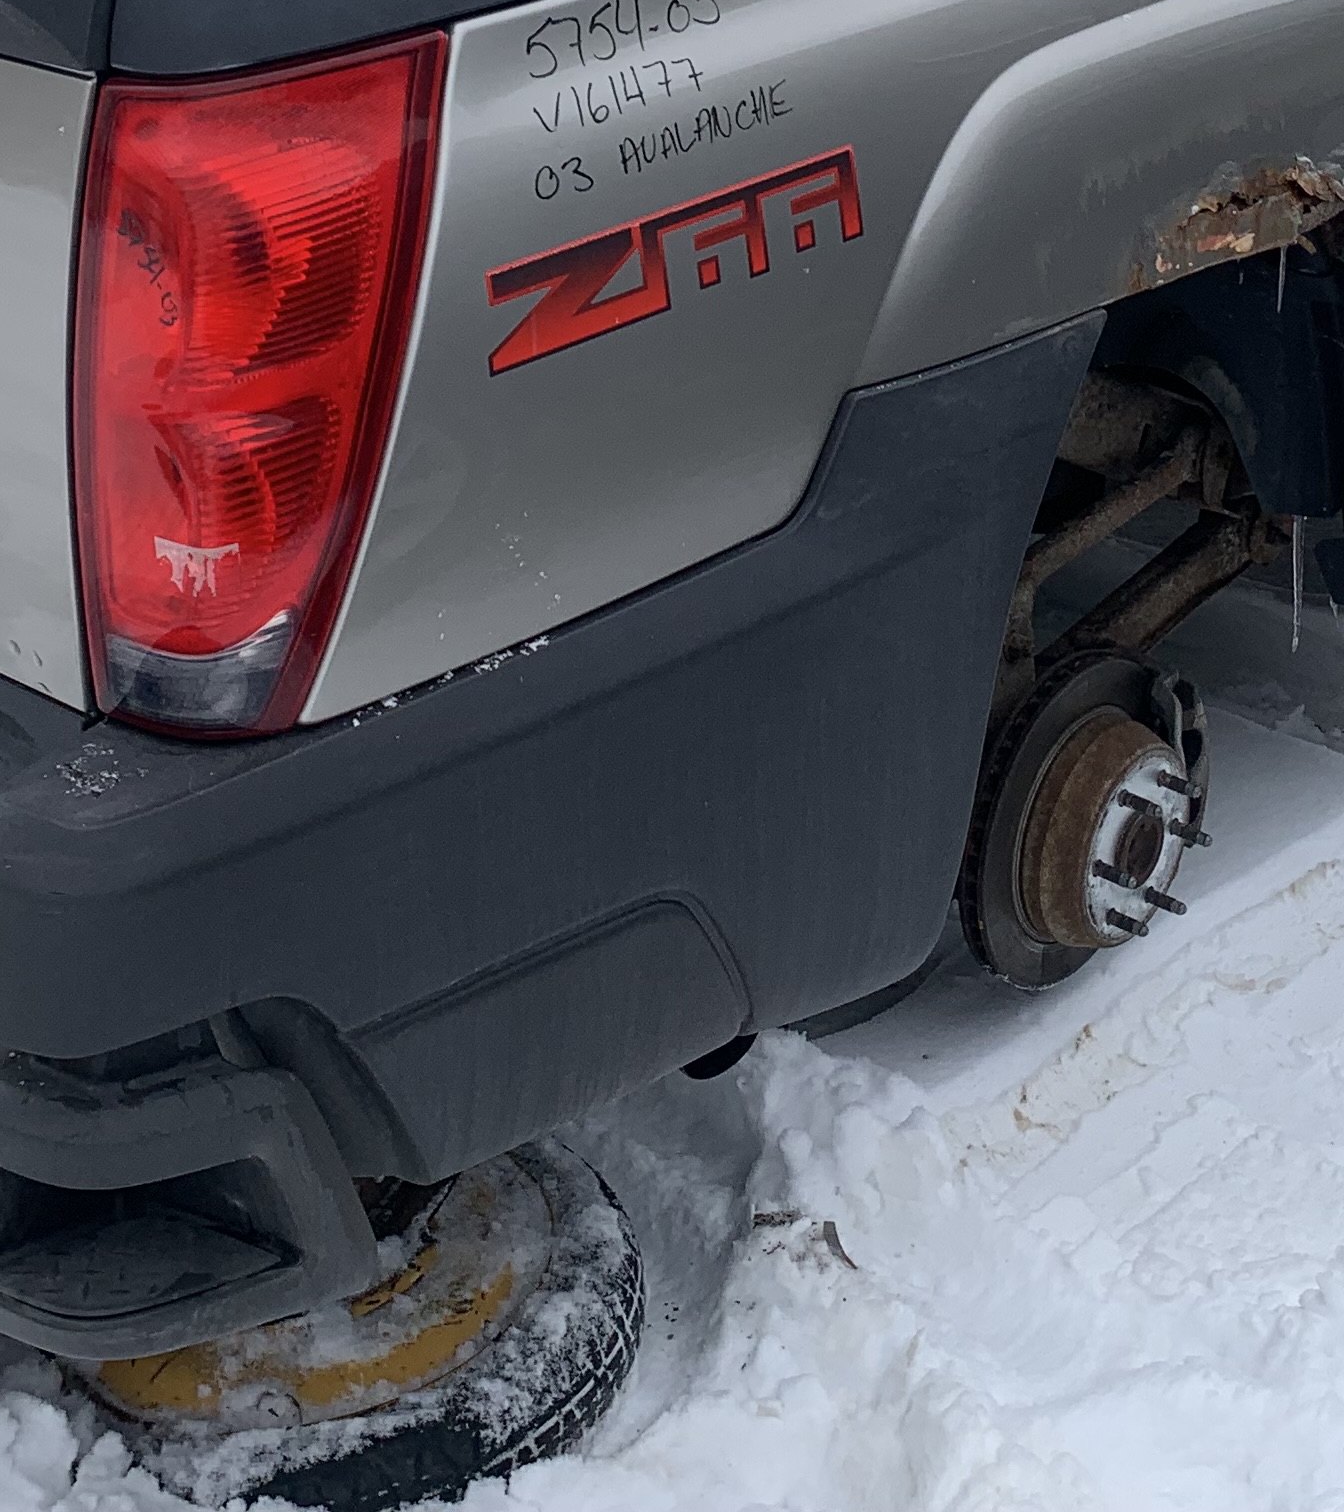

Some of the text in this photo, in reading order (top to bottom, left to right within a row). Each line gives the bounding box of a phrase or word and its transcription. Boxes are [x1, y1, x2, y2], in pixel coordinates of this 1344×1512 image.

[533, 58, 704, 133] V161477
[535, 79, 794, 200] 03 AVALANCHE
